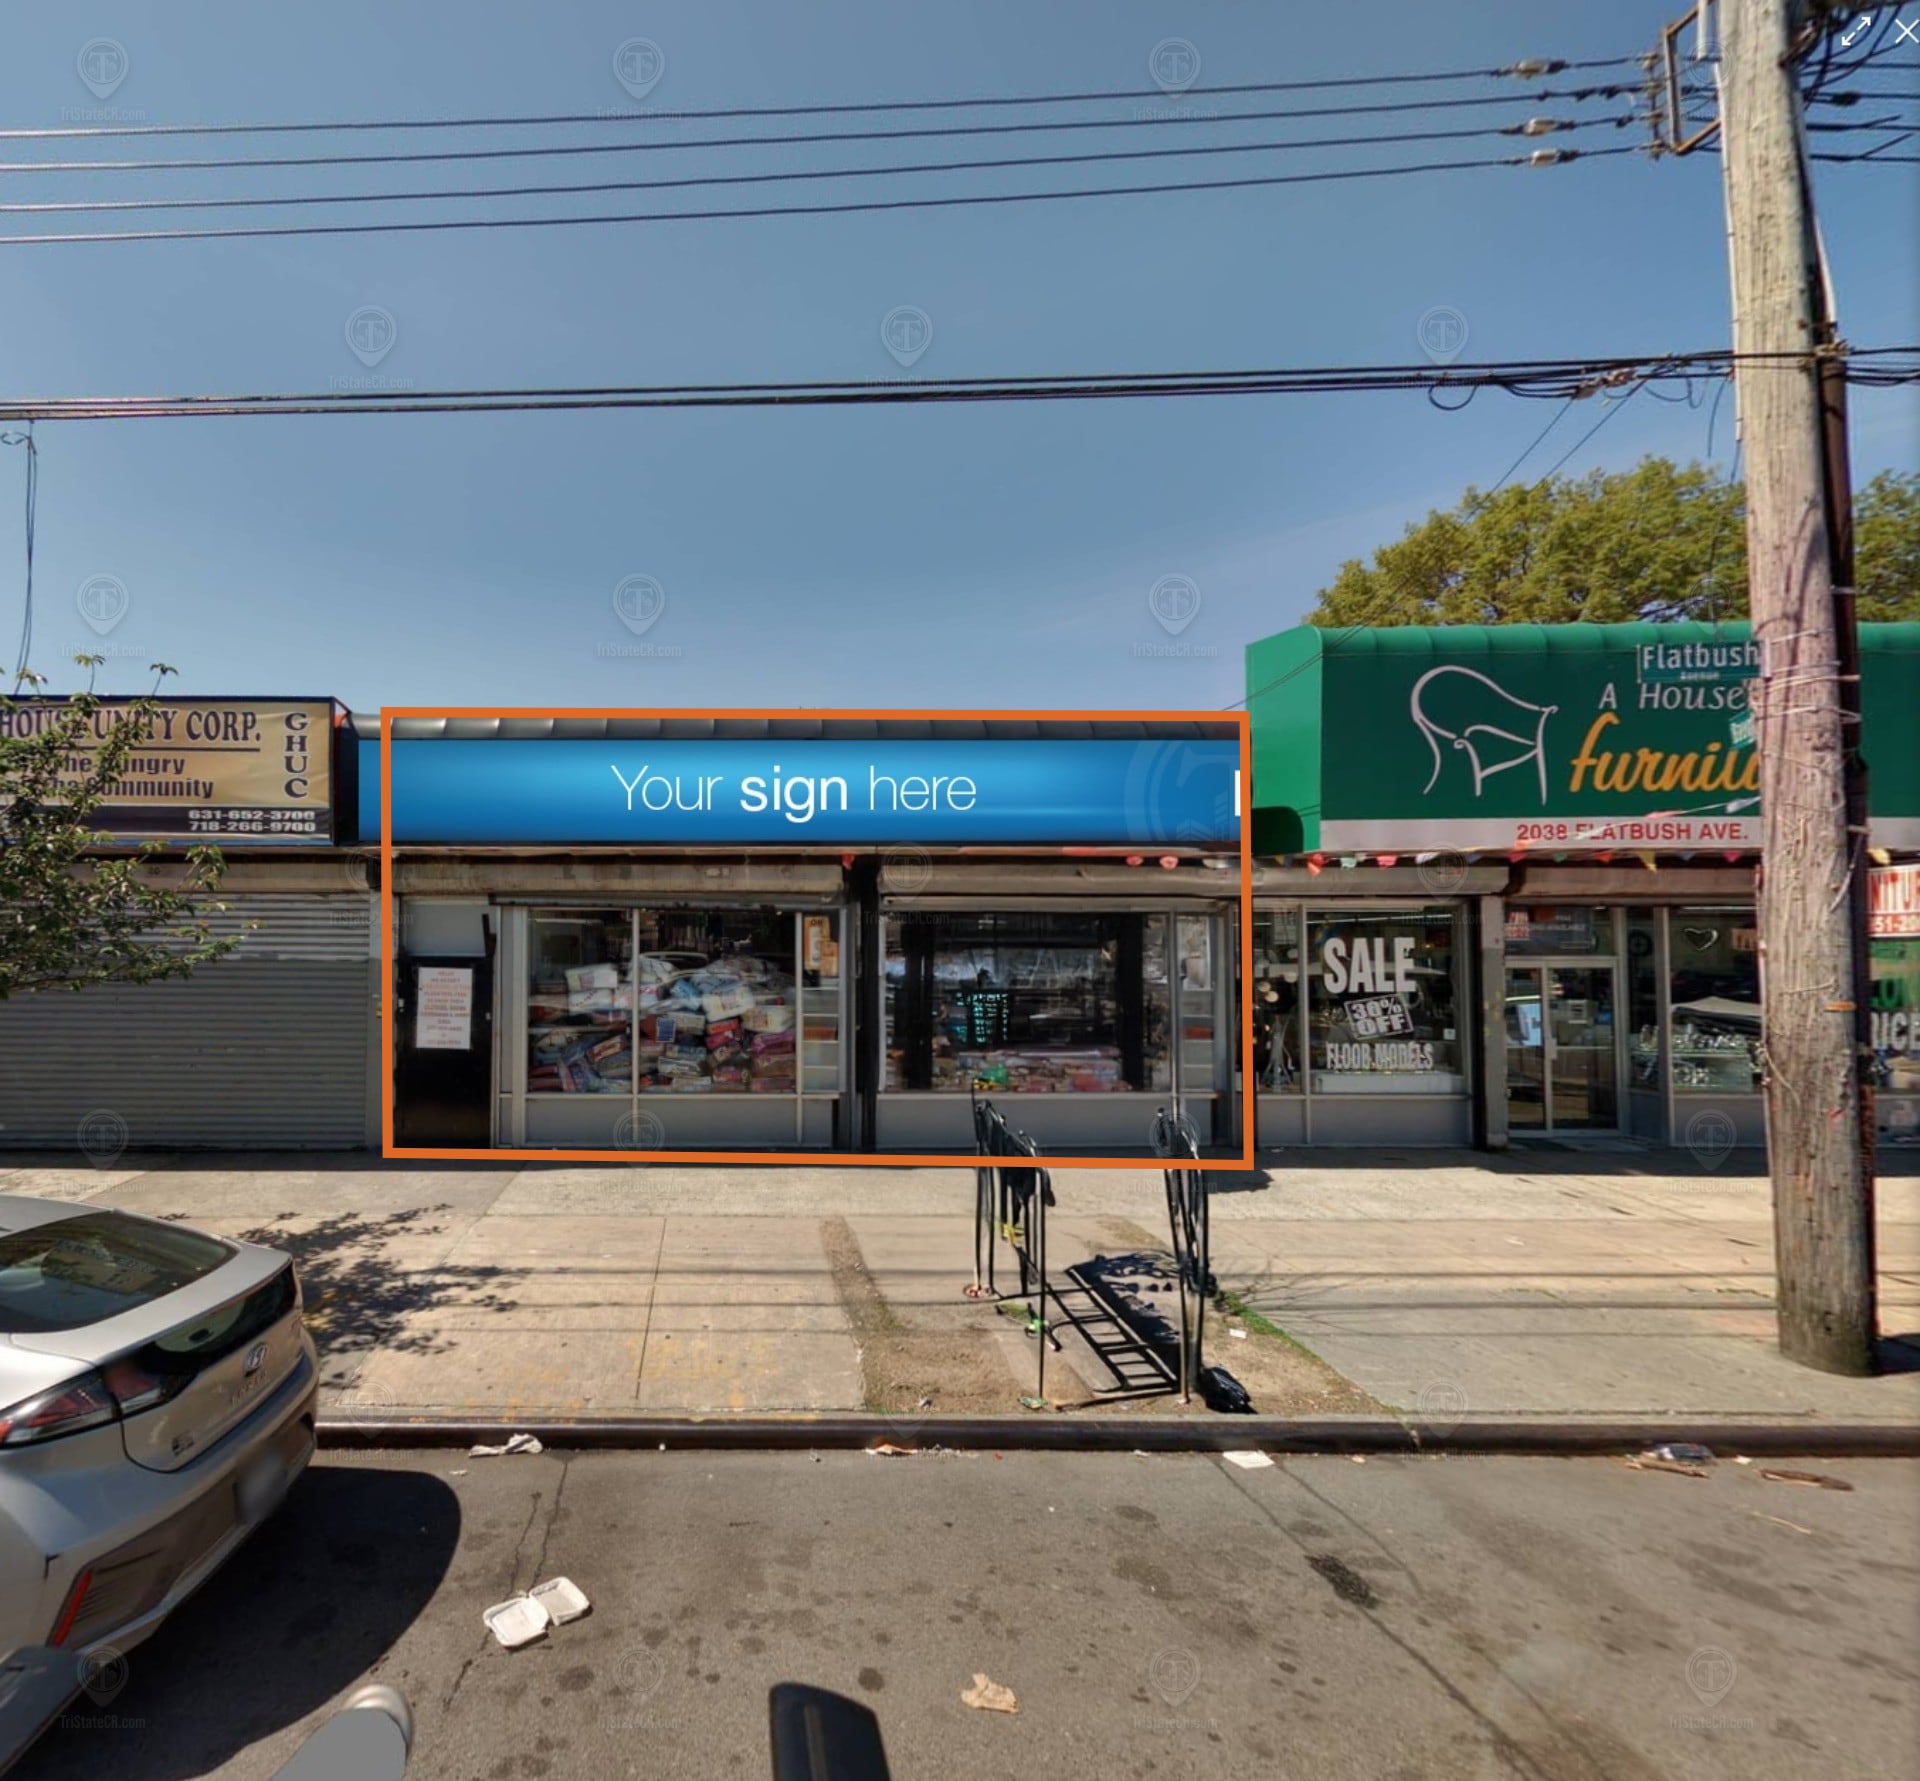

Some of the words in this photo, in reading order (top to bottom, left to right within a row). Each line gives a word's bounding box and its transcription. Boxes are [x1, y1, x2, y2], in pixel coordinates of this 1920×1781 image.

[1643, 640, 1759, 669] Flatbush
[1598, 682, 1618, 709] A
[185, 710, 261, 742] CORP.
[610, 764, 724, 811] Your
[740, 764, 848, 823] sign
[869, 764, 977, 811] here
[1516, 822, 1567, 841] 2038
[1575, 822, 1691, 841] FLATBUSH
[1698, 822, 1749, 841] AVE.
[1323, 936, 1417, 994] SALE
[1350, 997, 1402, 1020] 30%
[1356, 1013, 1406, 1035] OFF
[1326, 1041, 1371, 1069] FLOOR
